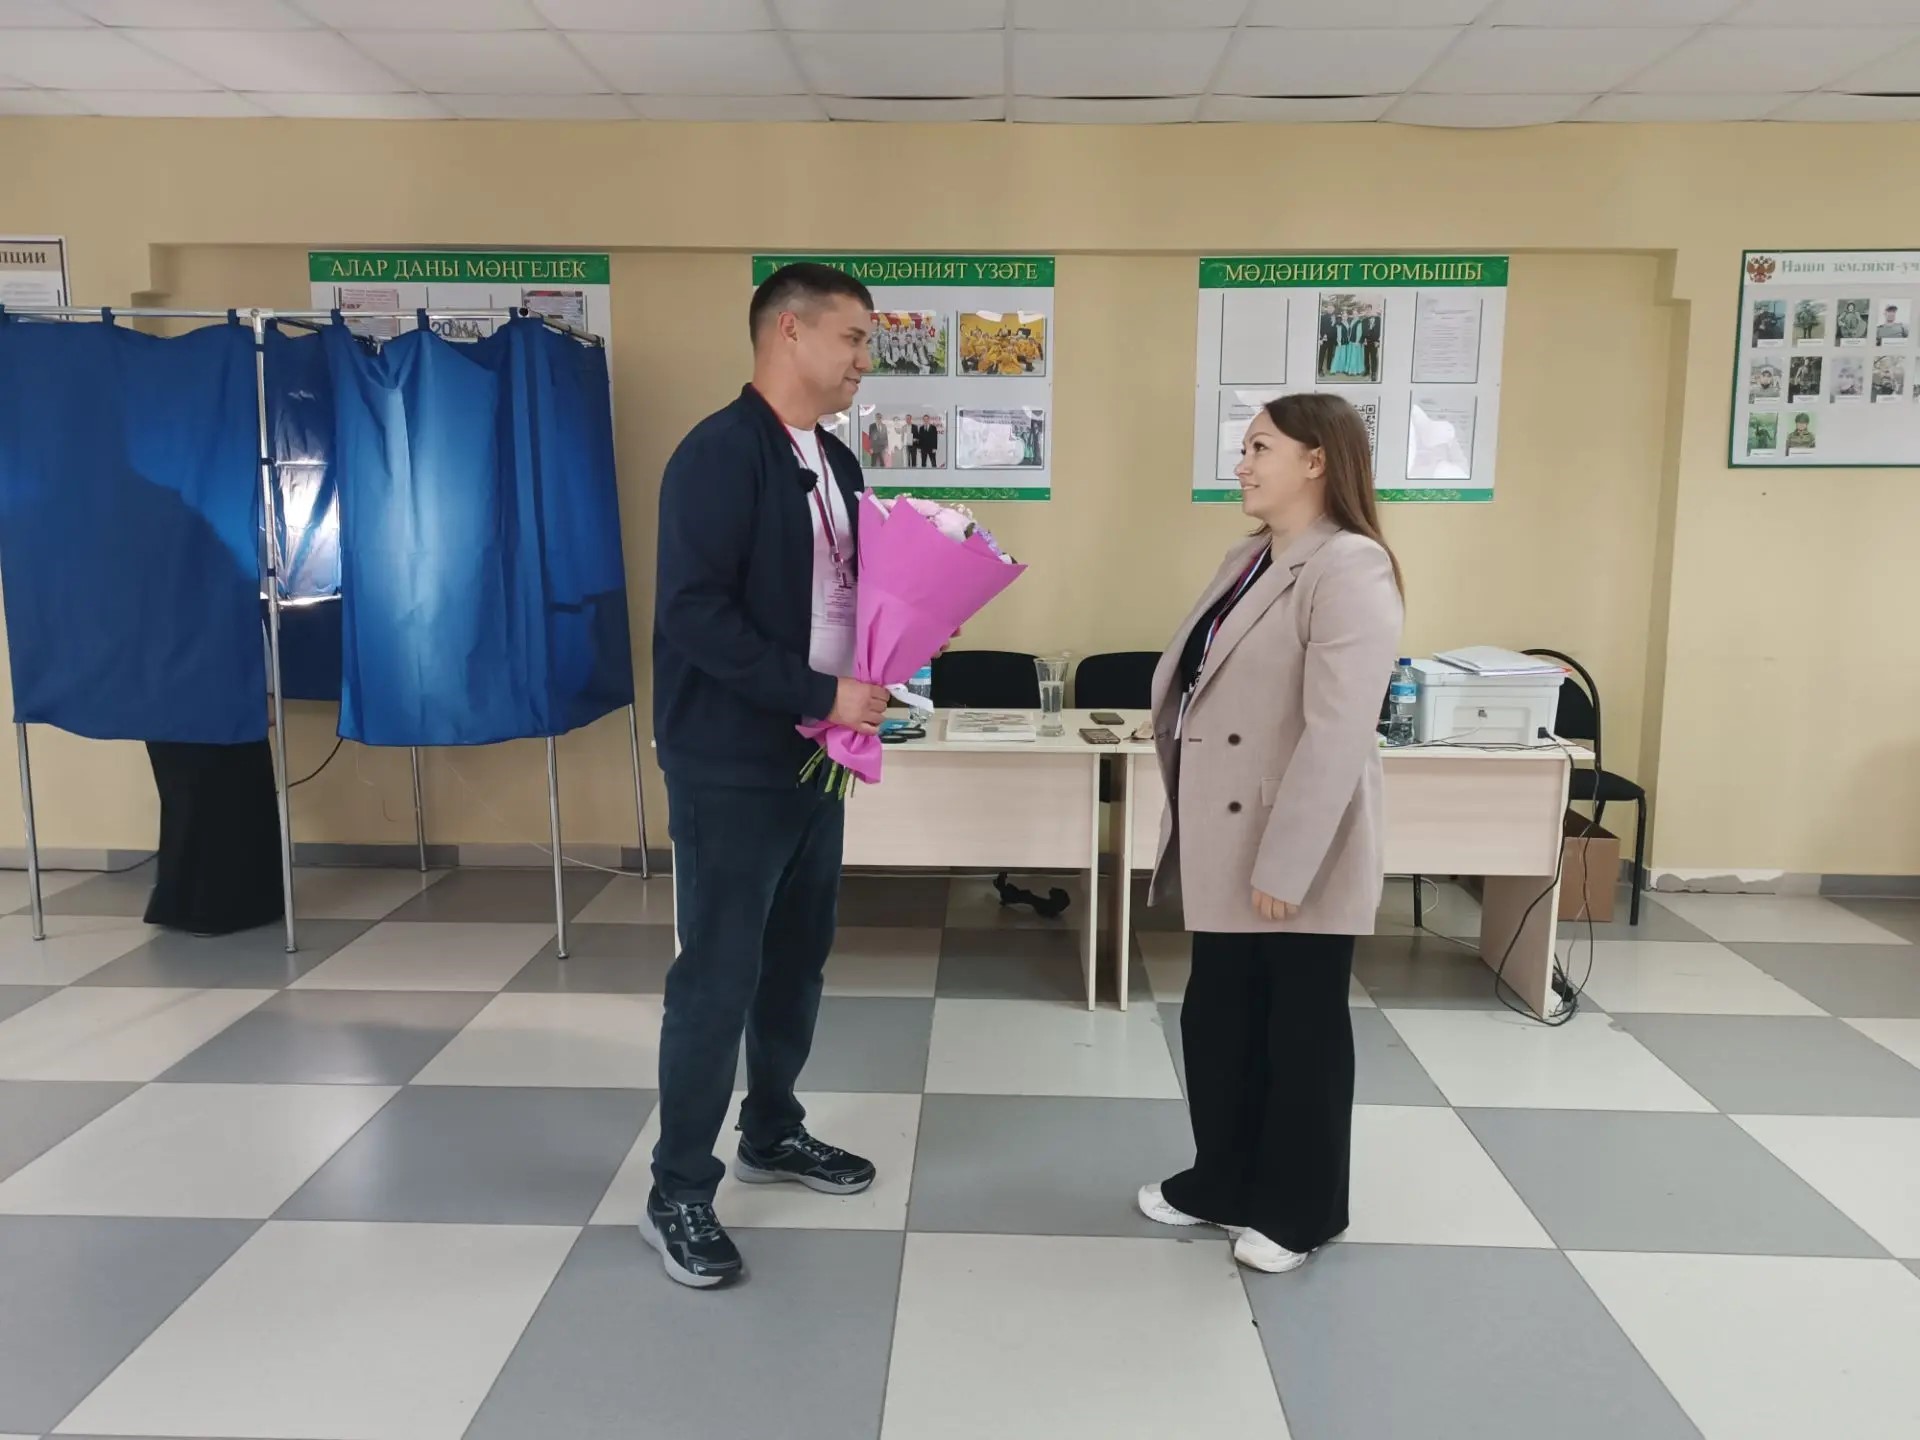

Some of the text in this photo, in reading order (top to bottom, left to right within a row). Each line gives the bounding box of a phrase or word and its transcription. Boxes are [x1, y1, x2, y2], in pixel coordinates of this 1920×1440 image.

[331, 259, 586, 280] АЛАР ДАНЫ МӘҢГЕЛЕК
[851, 262, 968, 282] МӘДӘНИЯТ
[973, 263, 1038, 279] ҮЗӘГЕ
[1226, 263, 1483, 285] МӘДӘНИЯТ ТОРМЫШЫ
[1781, 260, 1825, 273] Наши
